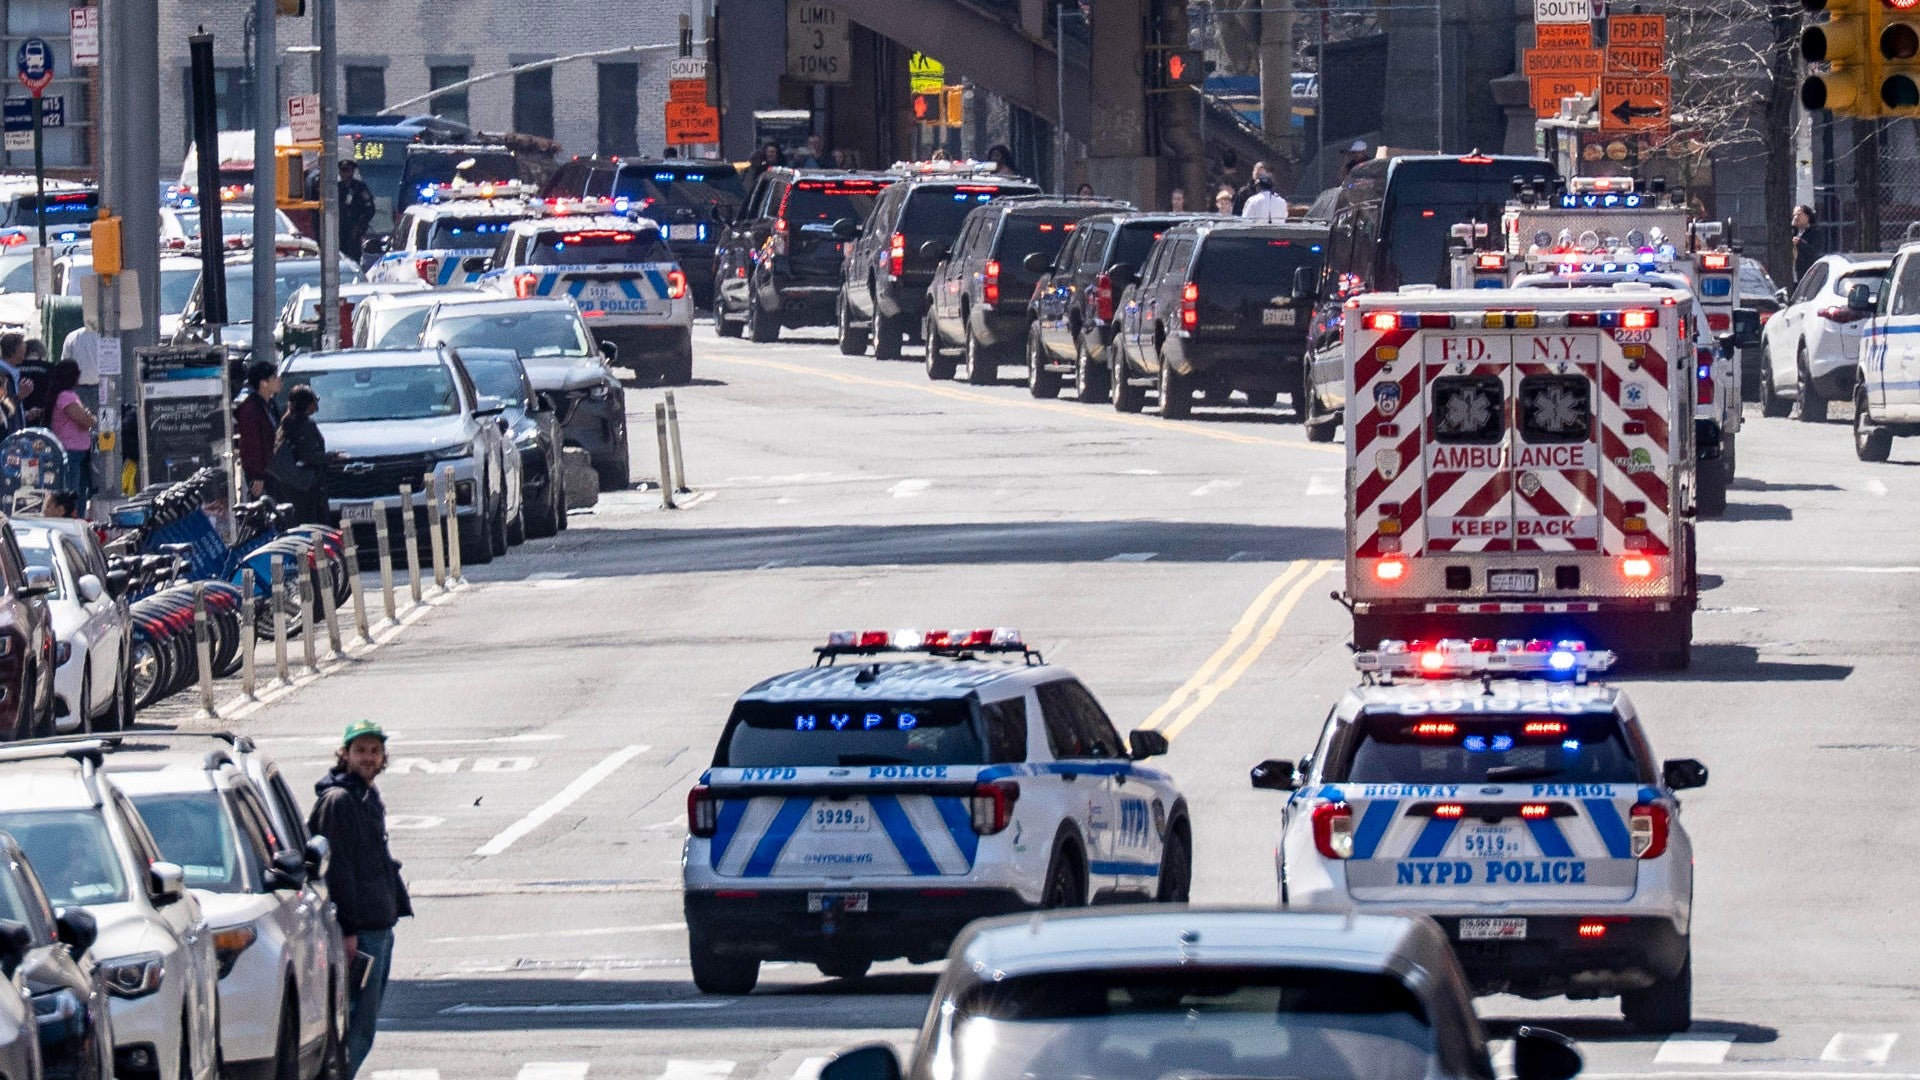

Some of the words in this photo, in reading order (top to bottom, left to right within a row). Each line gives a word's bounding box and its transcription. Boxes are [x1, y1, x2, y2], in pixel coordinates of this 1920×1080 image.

[1540, 2, 1586, 15] SOUTH
[1563, 28, 1589, 36] RIVER
[1614, 22, 1637, 38] FDR
[1642, 22, 1659, 38] DR
[813, 29, 824, 50] 3
[800, 56, 837, 73] TONS
[1529, 54, 1581, 69] BROOKLYN
[1584, 54, 1598, 68] BR
[1613, 51, 1660, 66] SOUTH
[671, 62, 707, 74] SOUTH
[1553, 84, 1575, 94] END
[1605, 81, 1664, 96] DETOUR
[1563, 195, 1639, 207] NYPD
[1559, 262, 1640, 274] NYPD
[600, 299, 647, 310] POLICE
[1615, 328, 1652, 342] 2230
[1441, 338, 1492, 360] F.D.
[1532, 336, 1581, 360] N.Y.
[1432, 445, 1585, 469] AMBULANCE
[1452, 520, 1507, 535] KEEP
[1517, 520, 1576, 535] BACK
[796, 713, 917, 731] NYPD
[740, 767, 798, 781] NYPD
[869, 765, 948, 779] POLICE
[1364, 784, 1459, 797] HIGHWAY
[1532, 784, 1616, 797] PATROL
[817, 809, 852, 824] 3929
[1466, 834, 1504, 851] 5919
[1396, 861, 1473, 884] NYPD
[1485, 861, 1586, 884] POLICE
